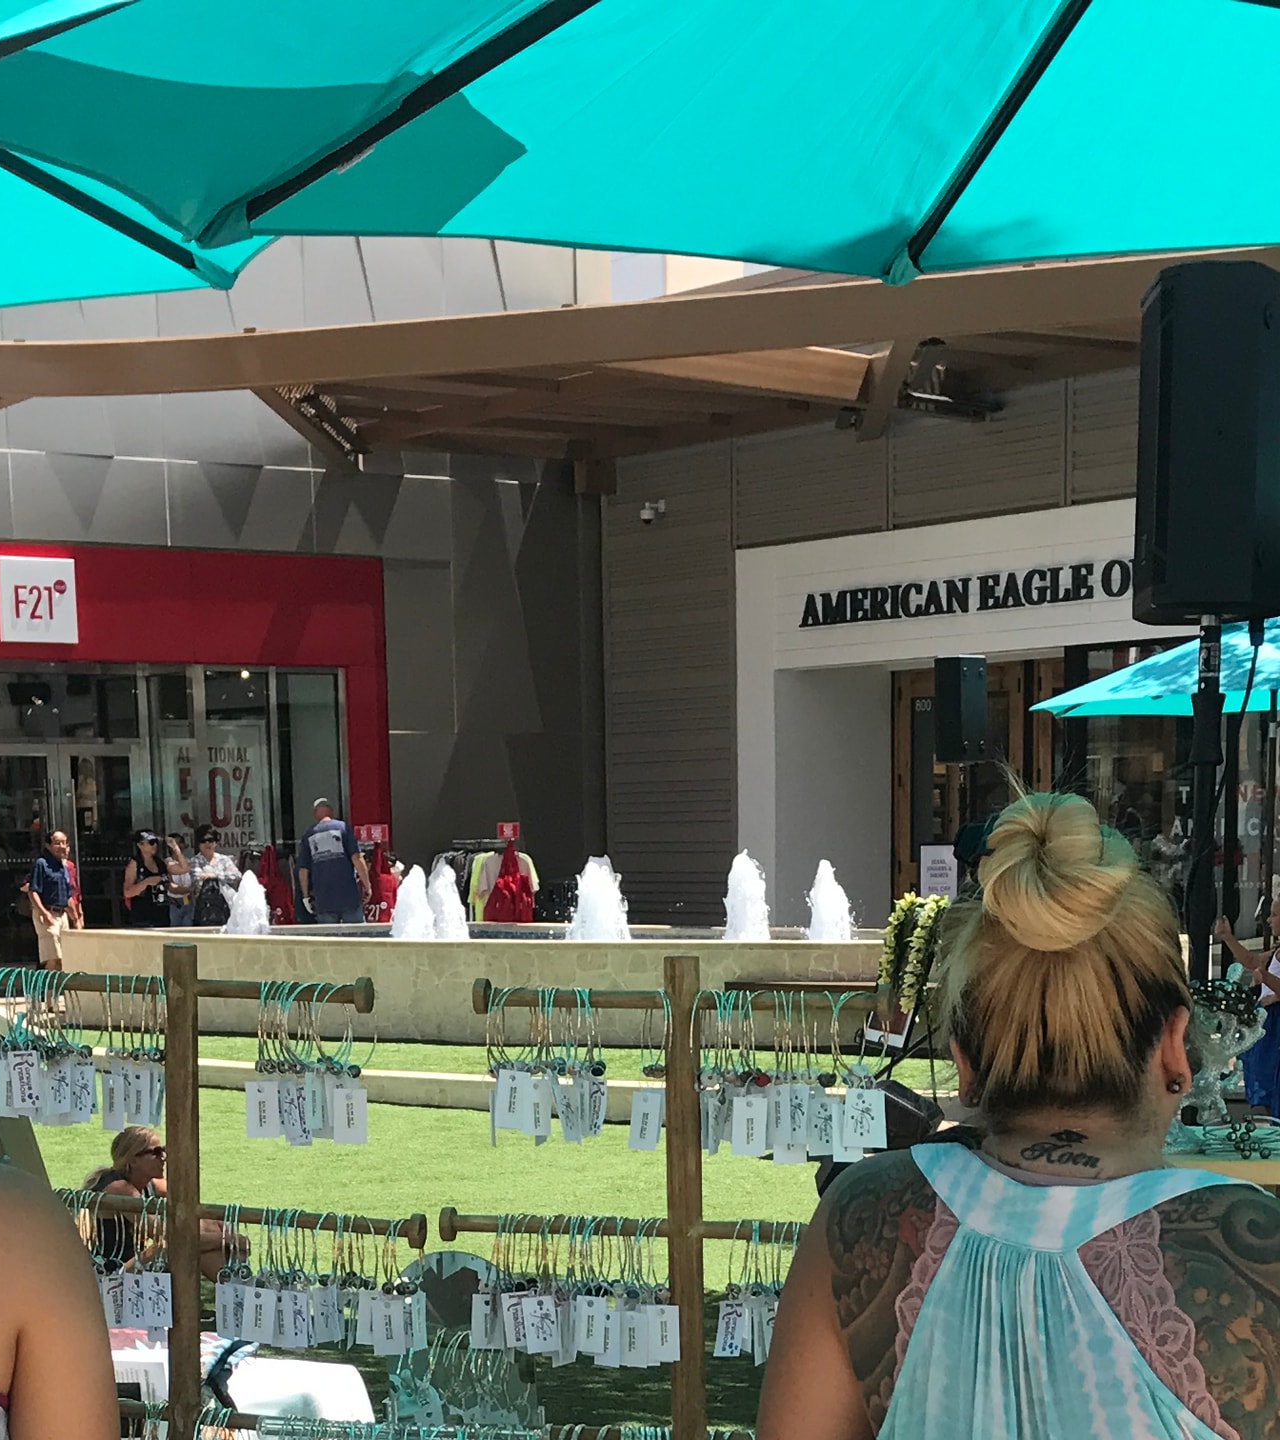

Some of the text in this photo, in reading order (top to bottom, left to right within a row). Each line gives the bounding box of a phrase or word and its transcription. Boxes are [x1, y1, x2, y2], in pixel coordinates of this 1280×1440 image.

[13, 584, 54, 621] F21
[799, 576, 972, 628] AMERICAN
[976, 562, 1095, 611] EAGLE
[915, 699, 932, 712] 800
[234, 813, 255, 828] OFF
